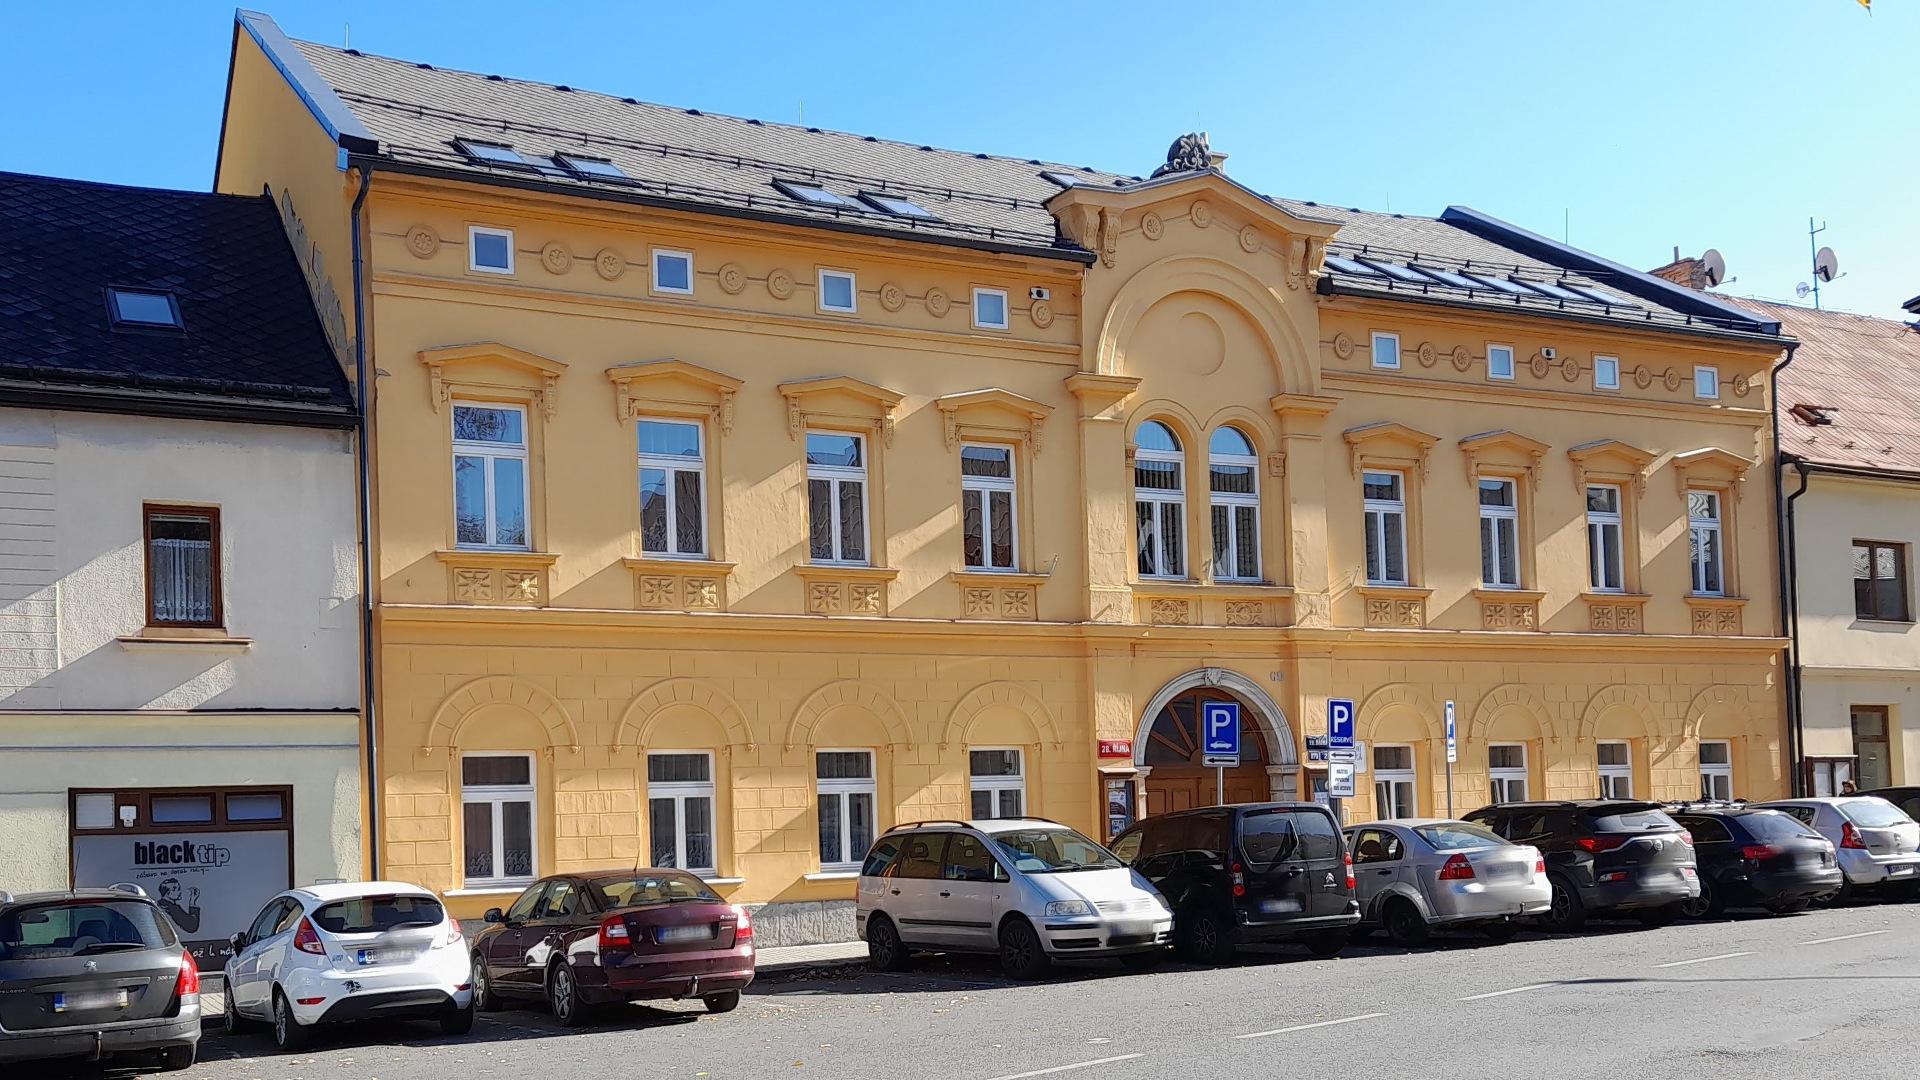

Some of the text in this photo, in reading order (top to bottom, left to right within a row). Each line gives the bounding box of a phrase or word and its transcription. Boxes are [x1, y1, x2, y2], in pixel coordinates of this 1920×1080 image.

[1211, 709, 1231, 738] P
[1333, 705, 1349, 733] P
[1101, 745, 1111, 753] 28.
[134, 840, 231, 867] black tip
